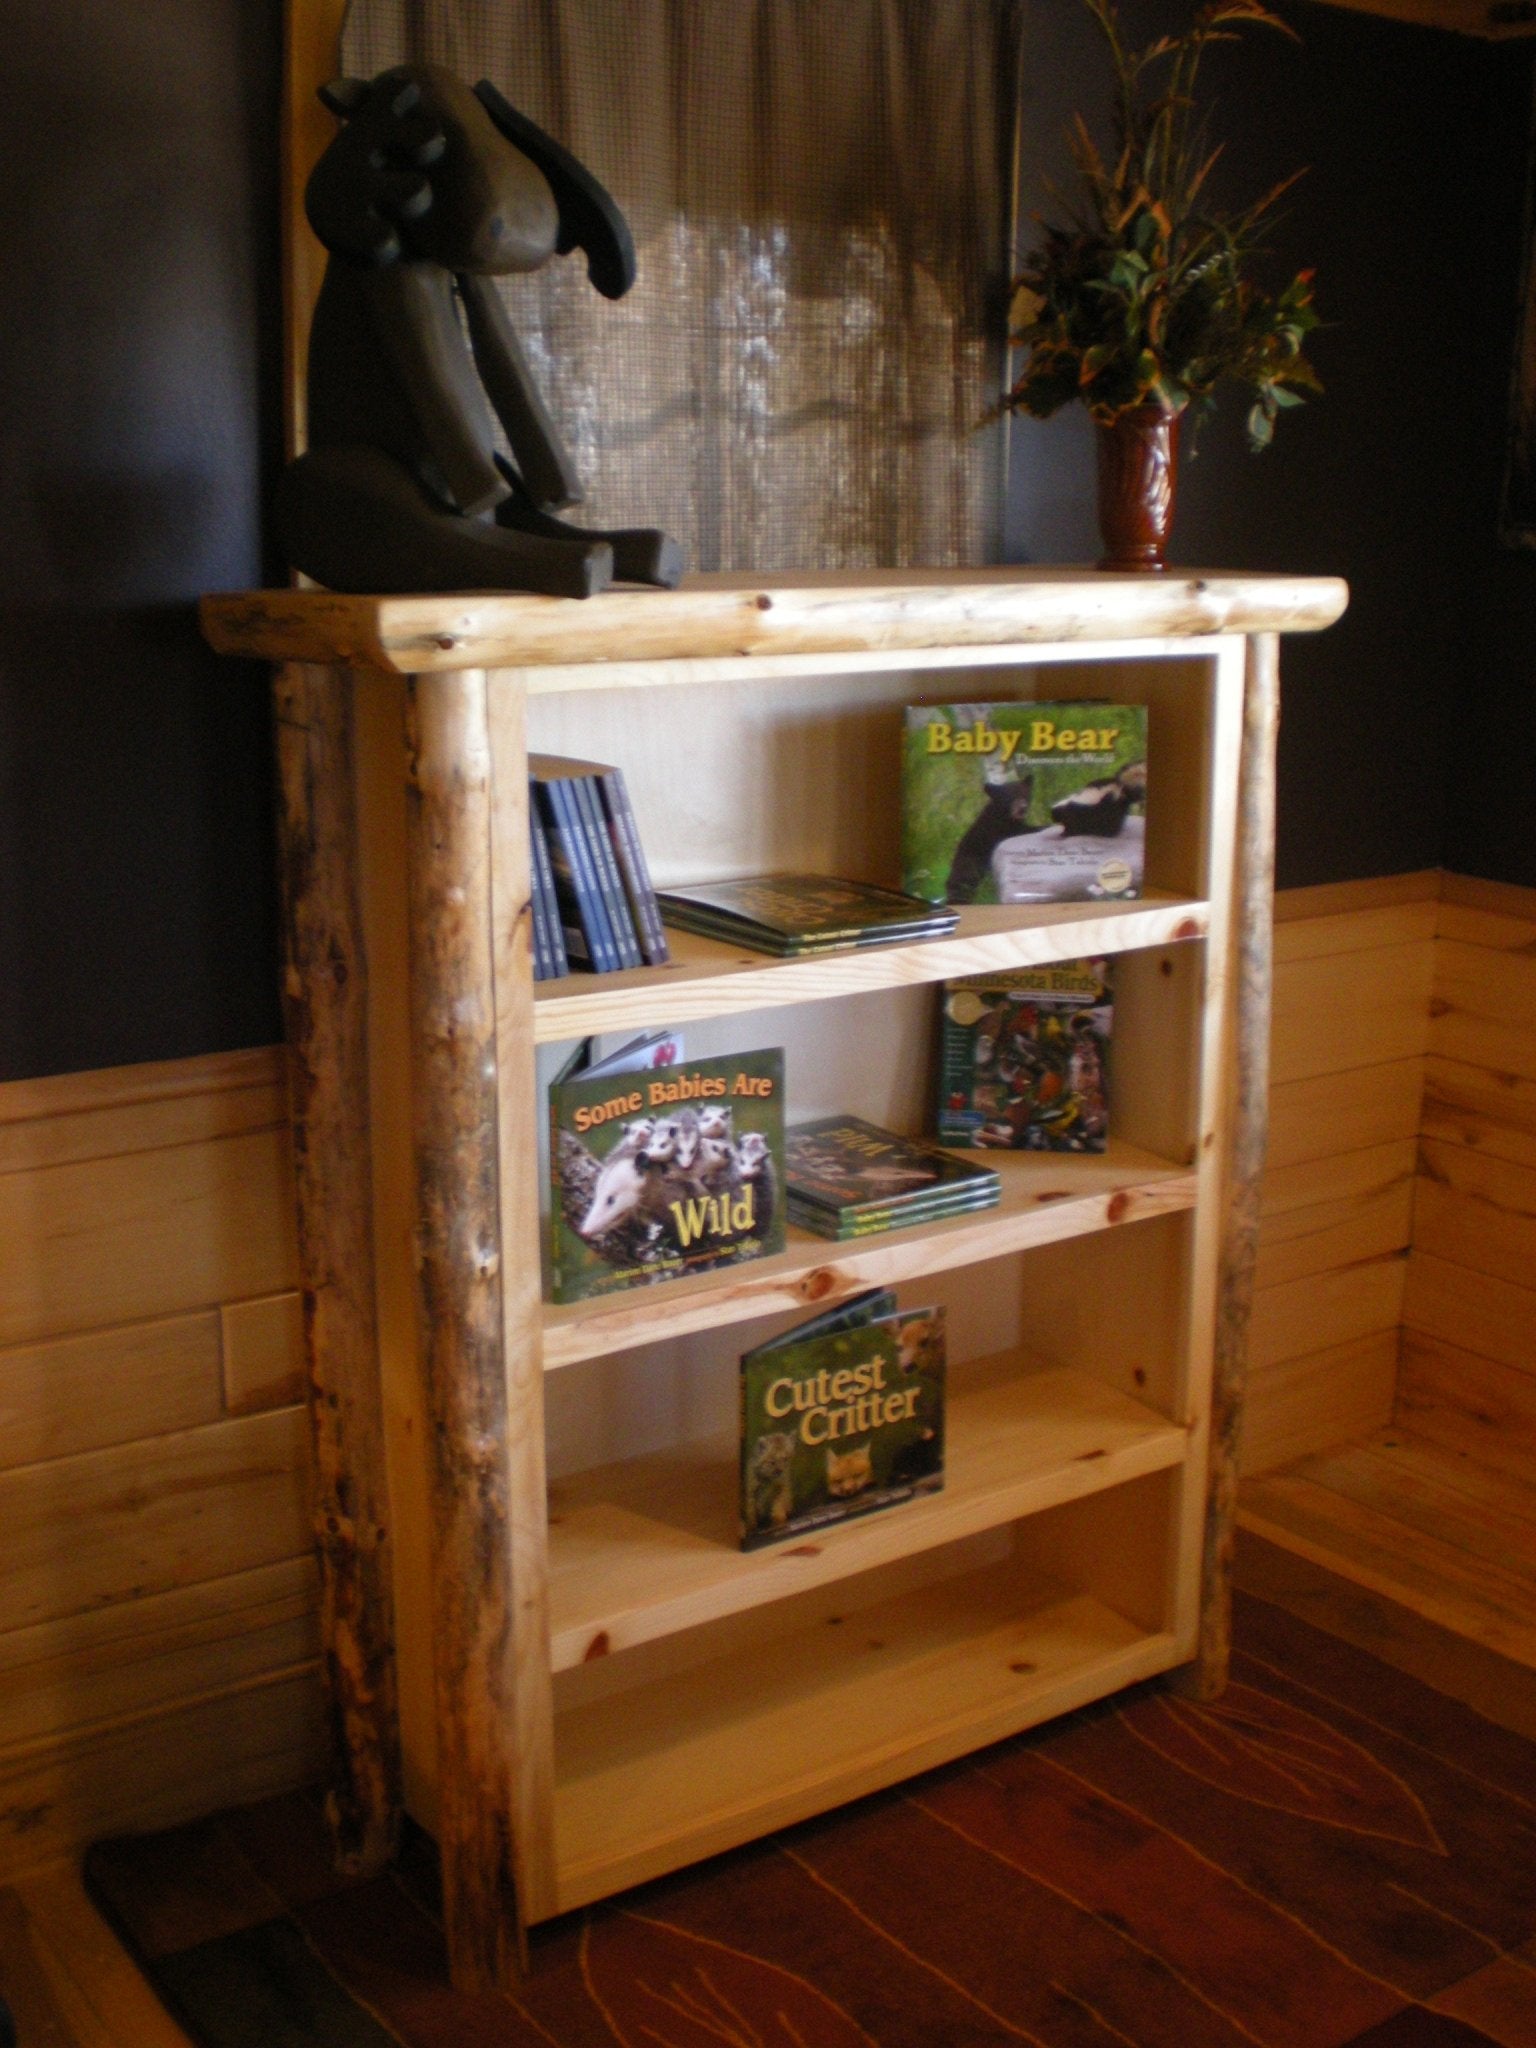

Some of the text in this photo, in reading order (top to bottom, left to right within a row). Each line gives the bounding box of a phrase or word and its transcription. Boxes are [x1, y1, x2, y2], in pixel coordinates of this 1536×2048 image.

[928, 720, 1119, 762] Baby Bear
[1052, 972, 1097, 990] Birds
[573, 1072, 774, 1133] Some Babies Are
[669, 1184, 756, 1248] Wild
[766, 1354, 887, 1419] Cutest
[801, 1387, 921, 1446] Critter
